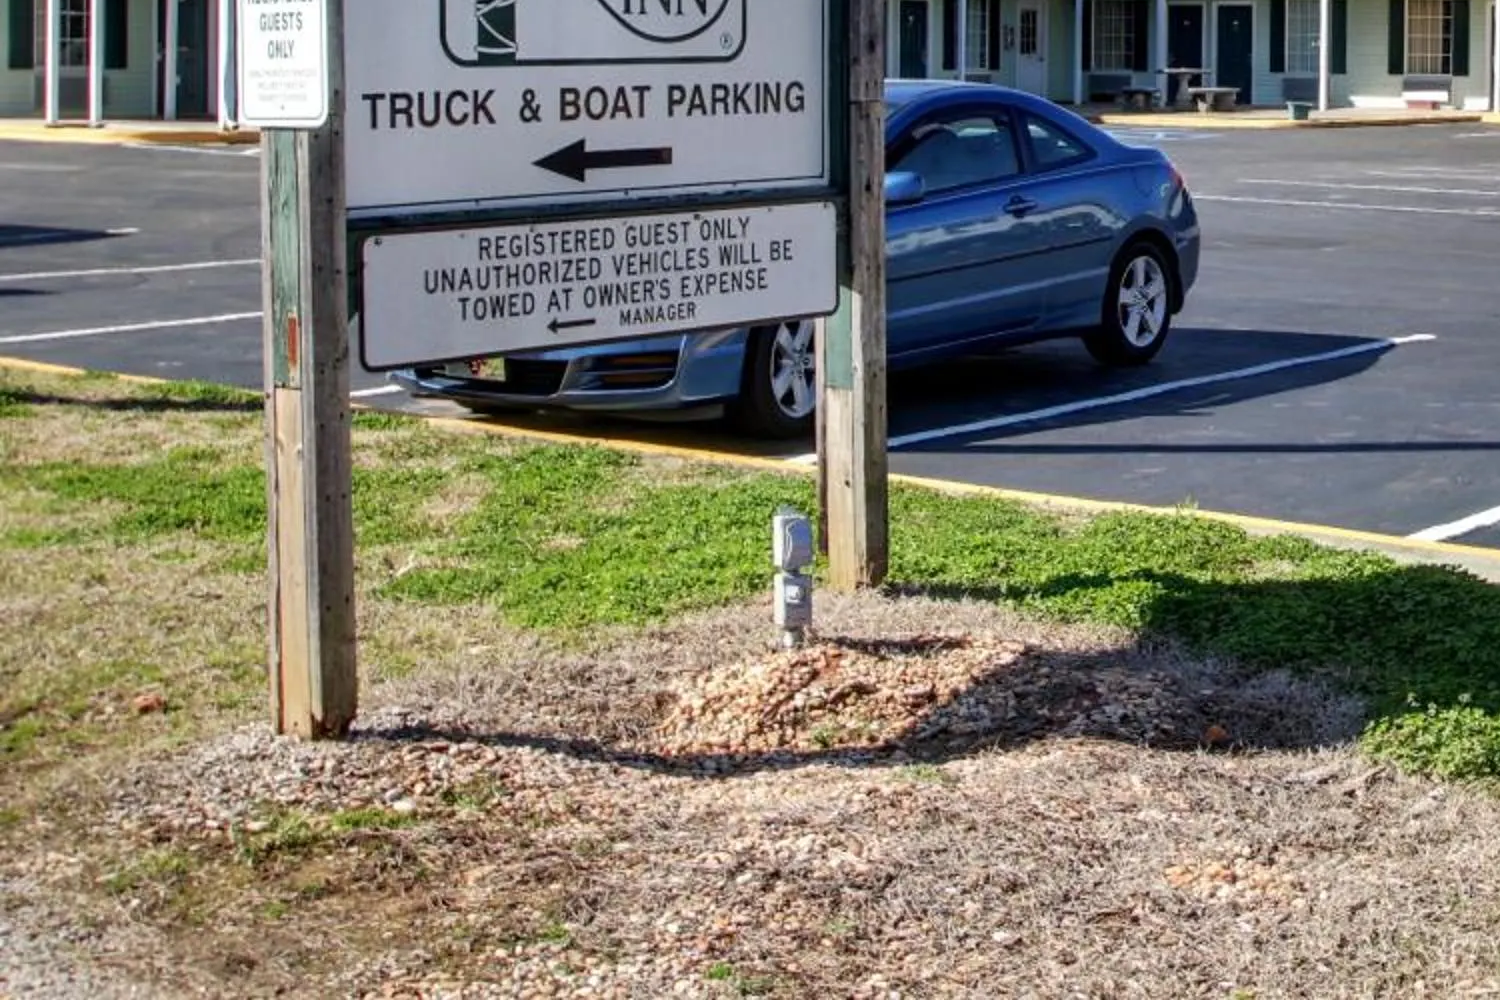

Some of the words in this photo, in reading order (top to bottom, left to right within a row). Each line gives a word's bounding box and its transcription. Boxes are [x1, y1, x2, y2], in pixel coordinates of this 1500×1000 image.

[260, 12, 303, 31] GUESTS
[267, 40, 294, 59] ONLY
[361, 89, 496, 129] TRUCK
[519, 88, 542, 123] &
[560, 85, 652, 121] BOAT
[667, 81, 805, 117] PARKING
[479, 227, 615, 260] REGISTERED
[625, 221, 690, 248] GUEST
[700, 216, 750, 241] ONLY
[424, 257, 601, 294] UNAUTHORIZED
[612, 247, 709, 277] VEHICLES
[718, 242, 762, 267] WILL
[770, 239, 793, 261] BE
[458, 292, 535, 321] TOWED
[547, 288, 573, 313] AT
[583, 278, 671, 309] OWNER'S
[681, 268, 768, 298] EXPENSE
[619, 301, 696, 326] MANAGER
